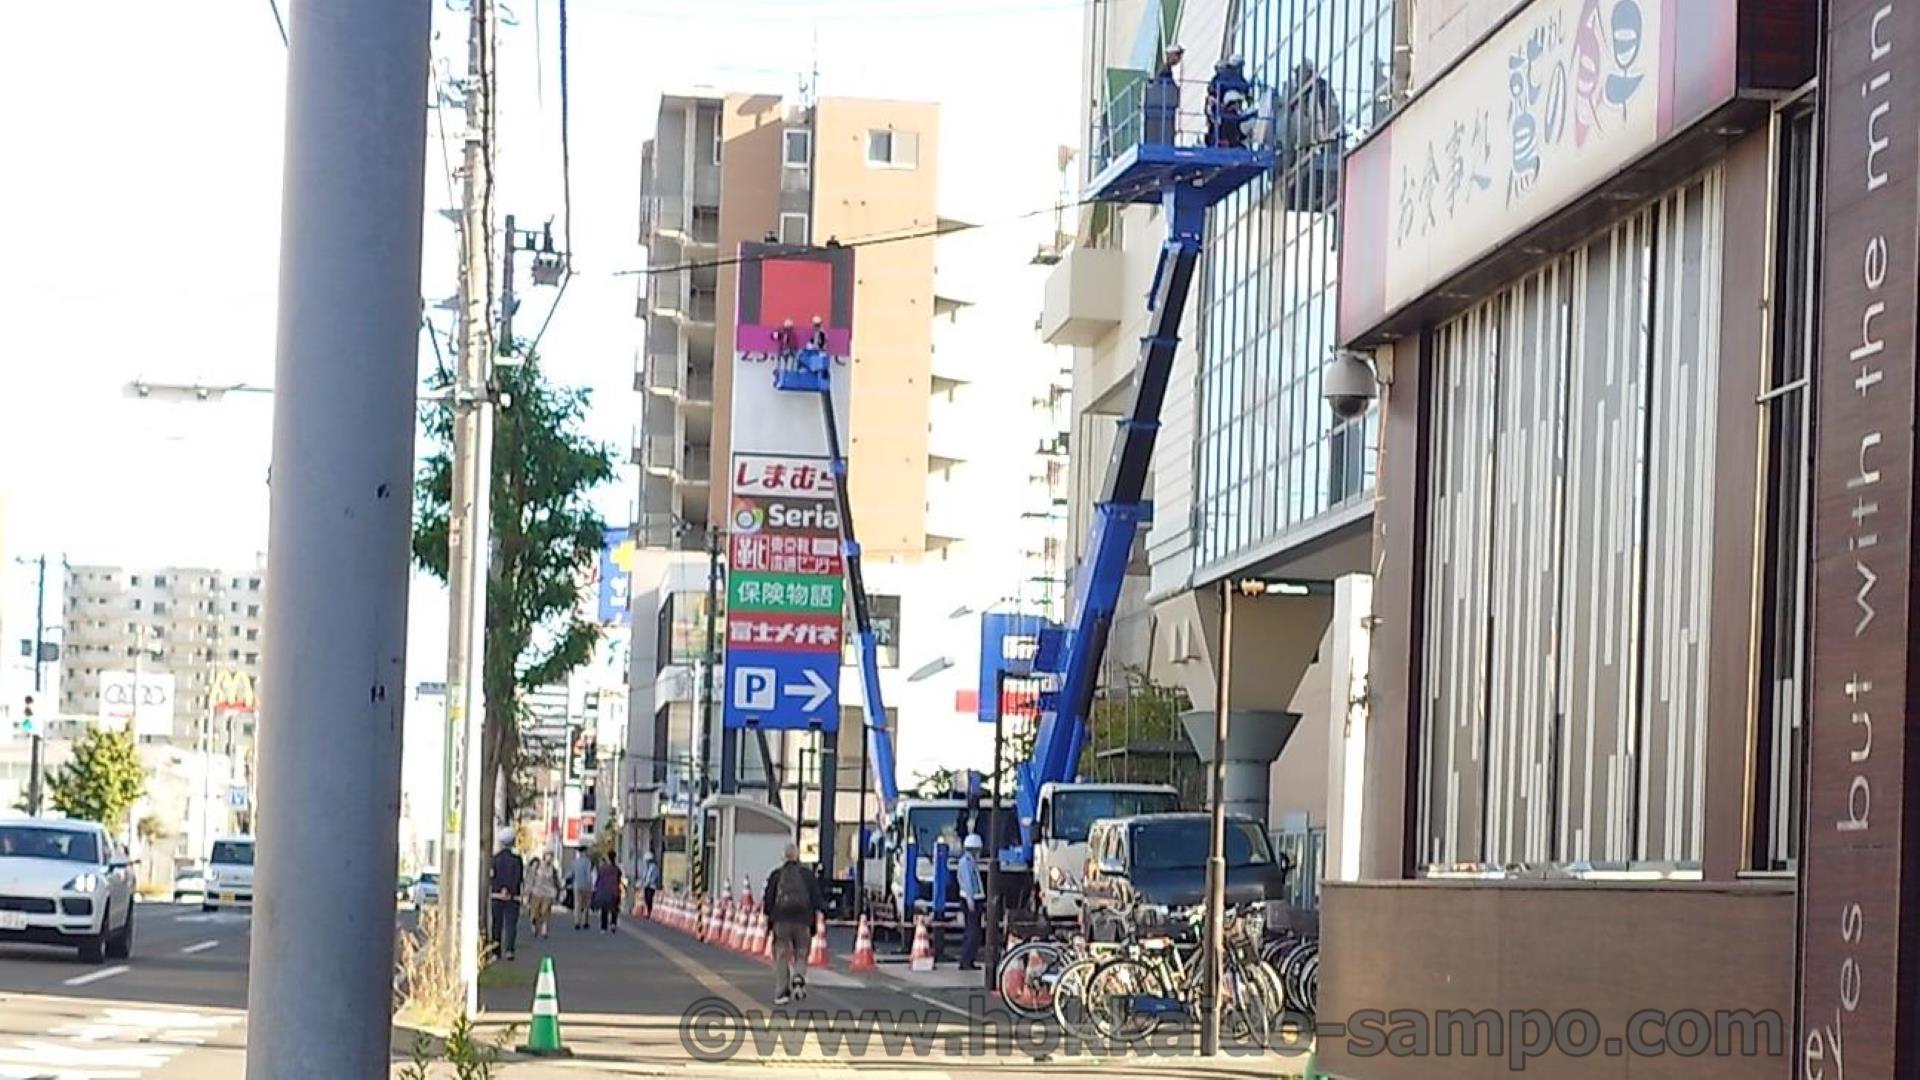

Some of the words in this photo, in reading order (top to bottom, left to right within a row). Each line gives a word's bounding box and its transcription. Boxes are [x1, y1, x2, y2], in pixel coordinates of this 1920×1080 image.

[1861, 3, 1893, 192] min
[1397, 107, 1492, 248] お食事処
[1849, 234, 1888, 398] the
[768, 503, 839, 529] Seria
[1846, 430, 1882, 638] with
[738, 581, 833, 607] 保険物語
[746, 673, 767, 704] P
[1836, 671, 1873, 832] but
